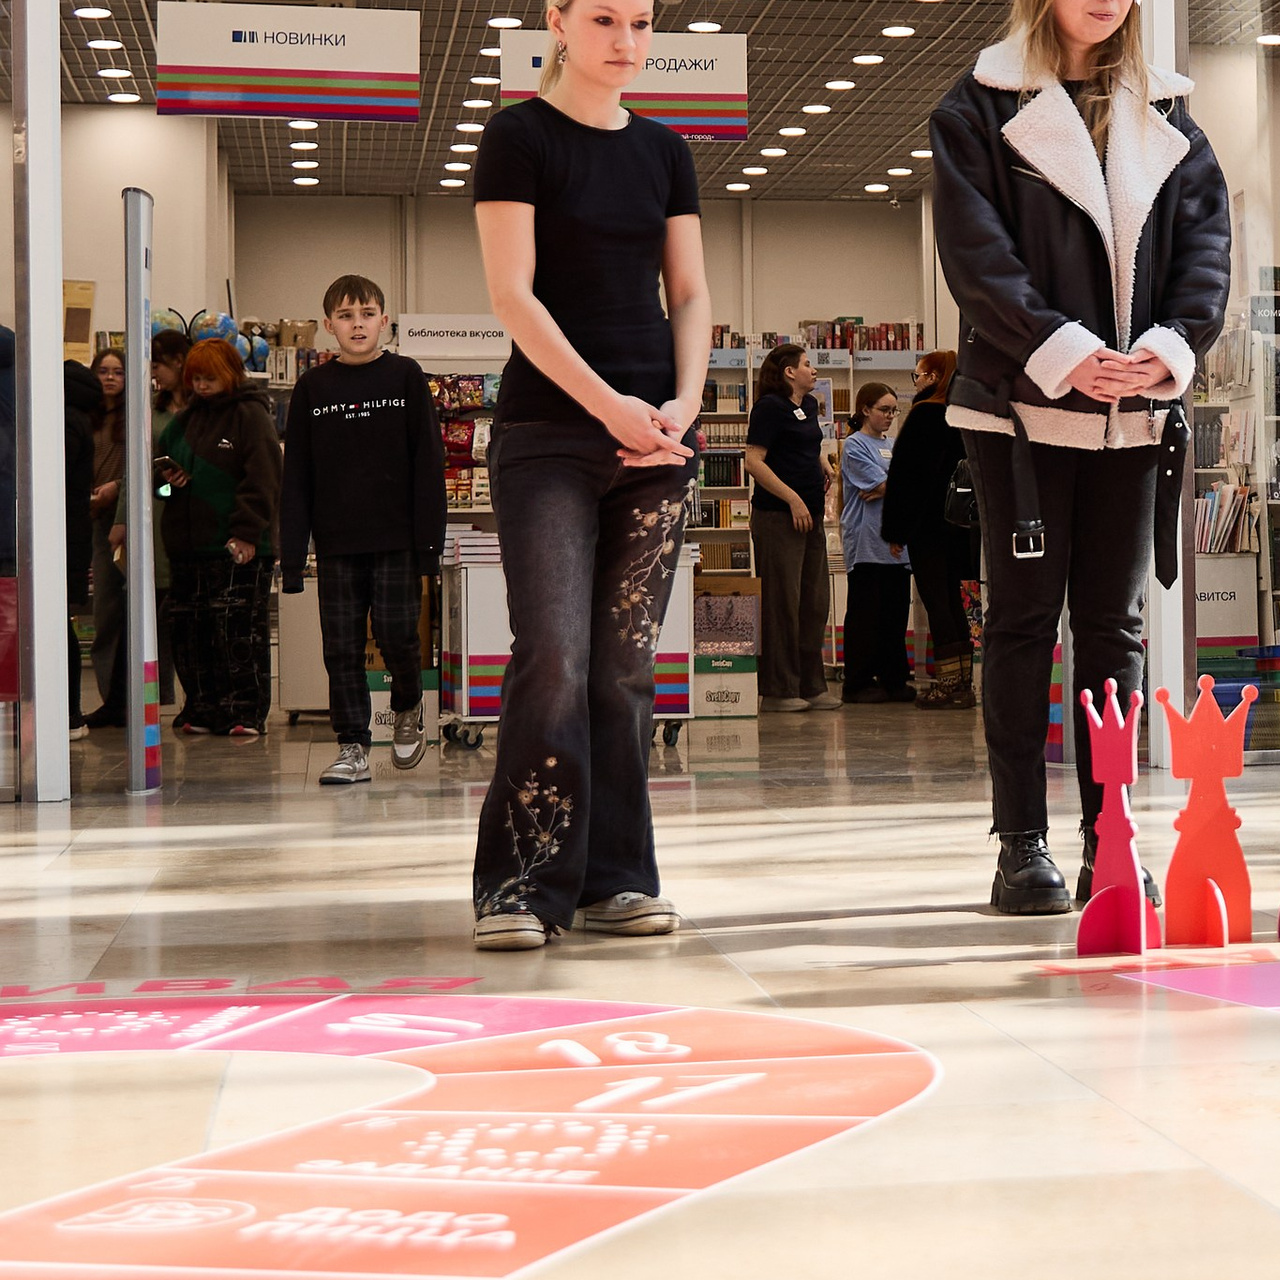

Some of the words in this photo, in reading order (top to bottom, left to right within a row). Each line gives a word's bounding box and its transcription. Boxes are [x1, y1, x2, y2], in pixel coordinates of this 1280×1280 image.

[263, 31, 346, 46] НОВИНКИ
[642, 58, 718, 72] РОДАЖИ
[408, 328, 467, 338] библиотека
[469, 332, 504, 341] вкусов
[538, 1030, 692, 1066] 18
[573, 1073, 767, 1110] 17
[295, 1160, 600, 1183] ЗАДАНИЕ
[277, 1206, 510, 1227] ДОДО
[240, 1222, 517, 1250] ПИЦЦА
